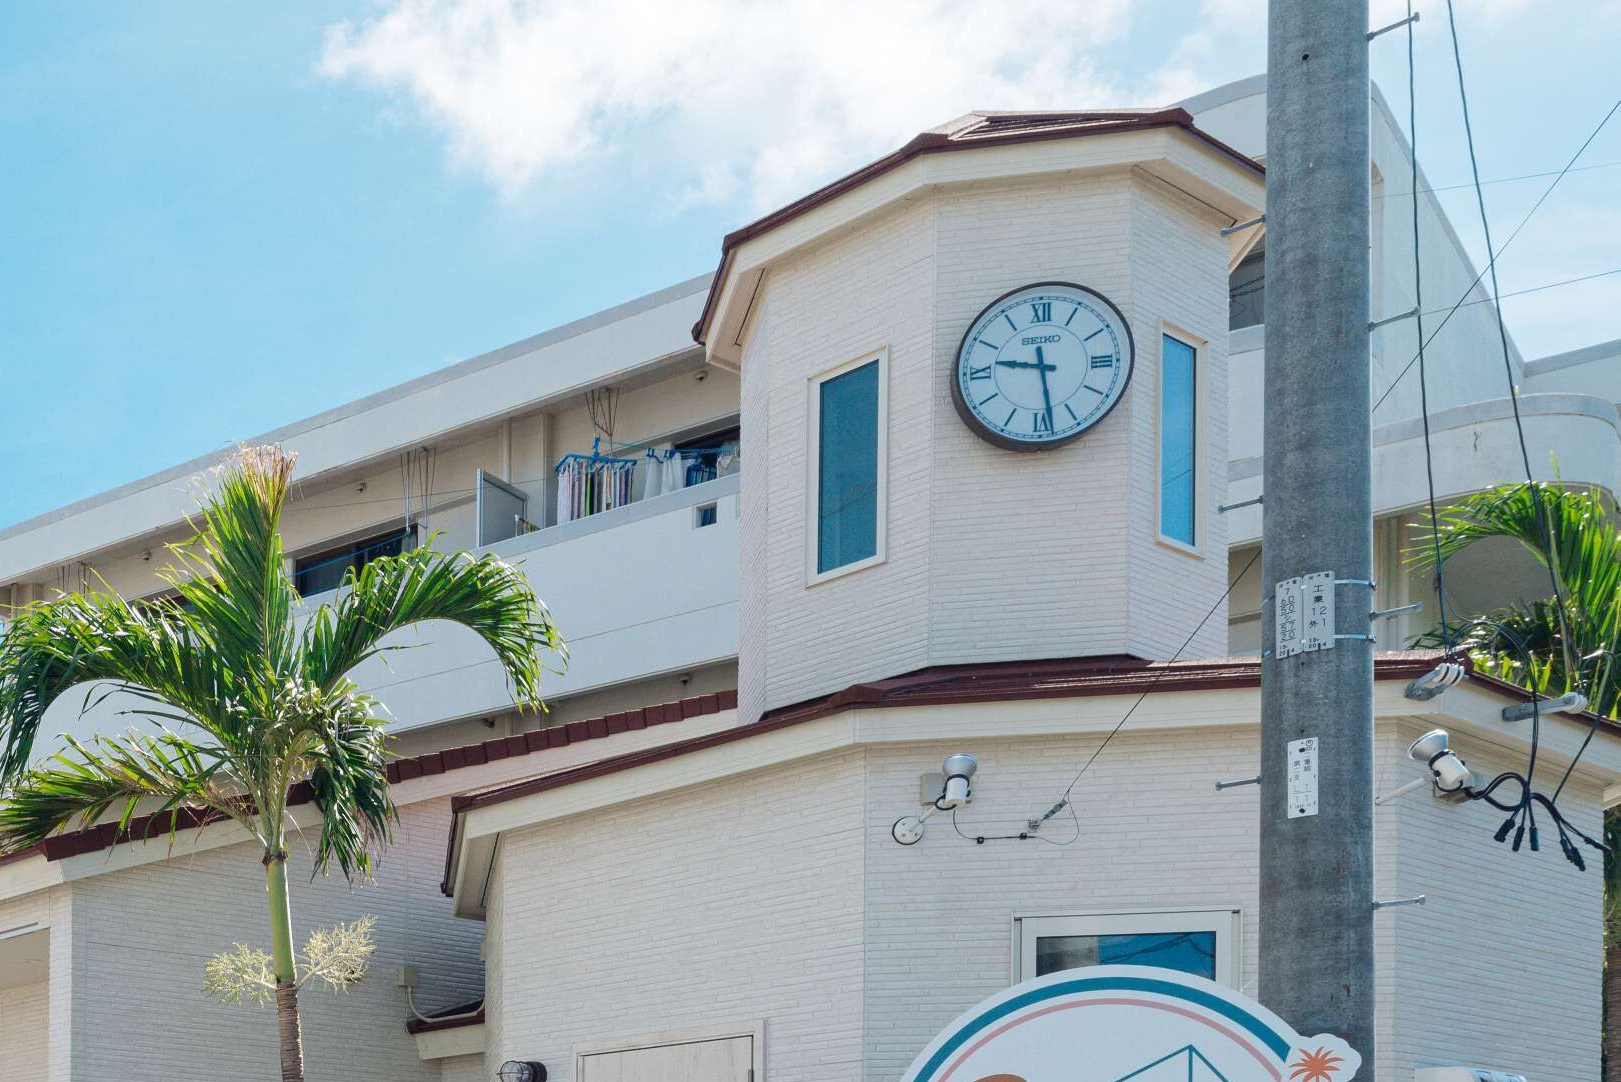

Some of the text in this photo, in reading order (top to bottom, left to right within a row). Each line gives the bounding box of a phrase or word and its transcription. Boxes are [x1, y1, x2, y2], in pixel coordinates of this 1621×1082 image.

[1030, 302, 1053, 323] XII
[1021, 334, 1061, 345] SEIKO
[1091, 354, 1113, 369] III
